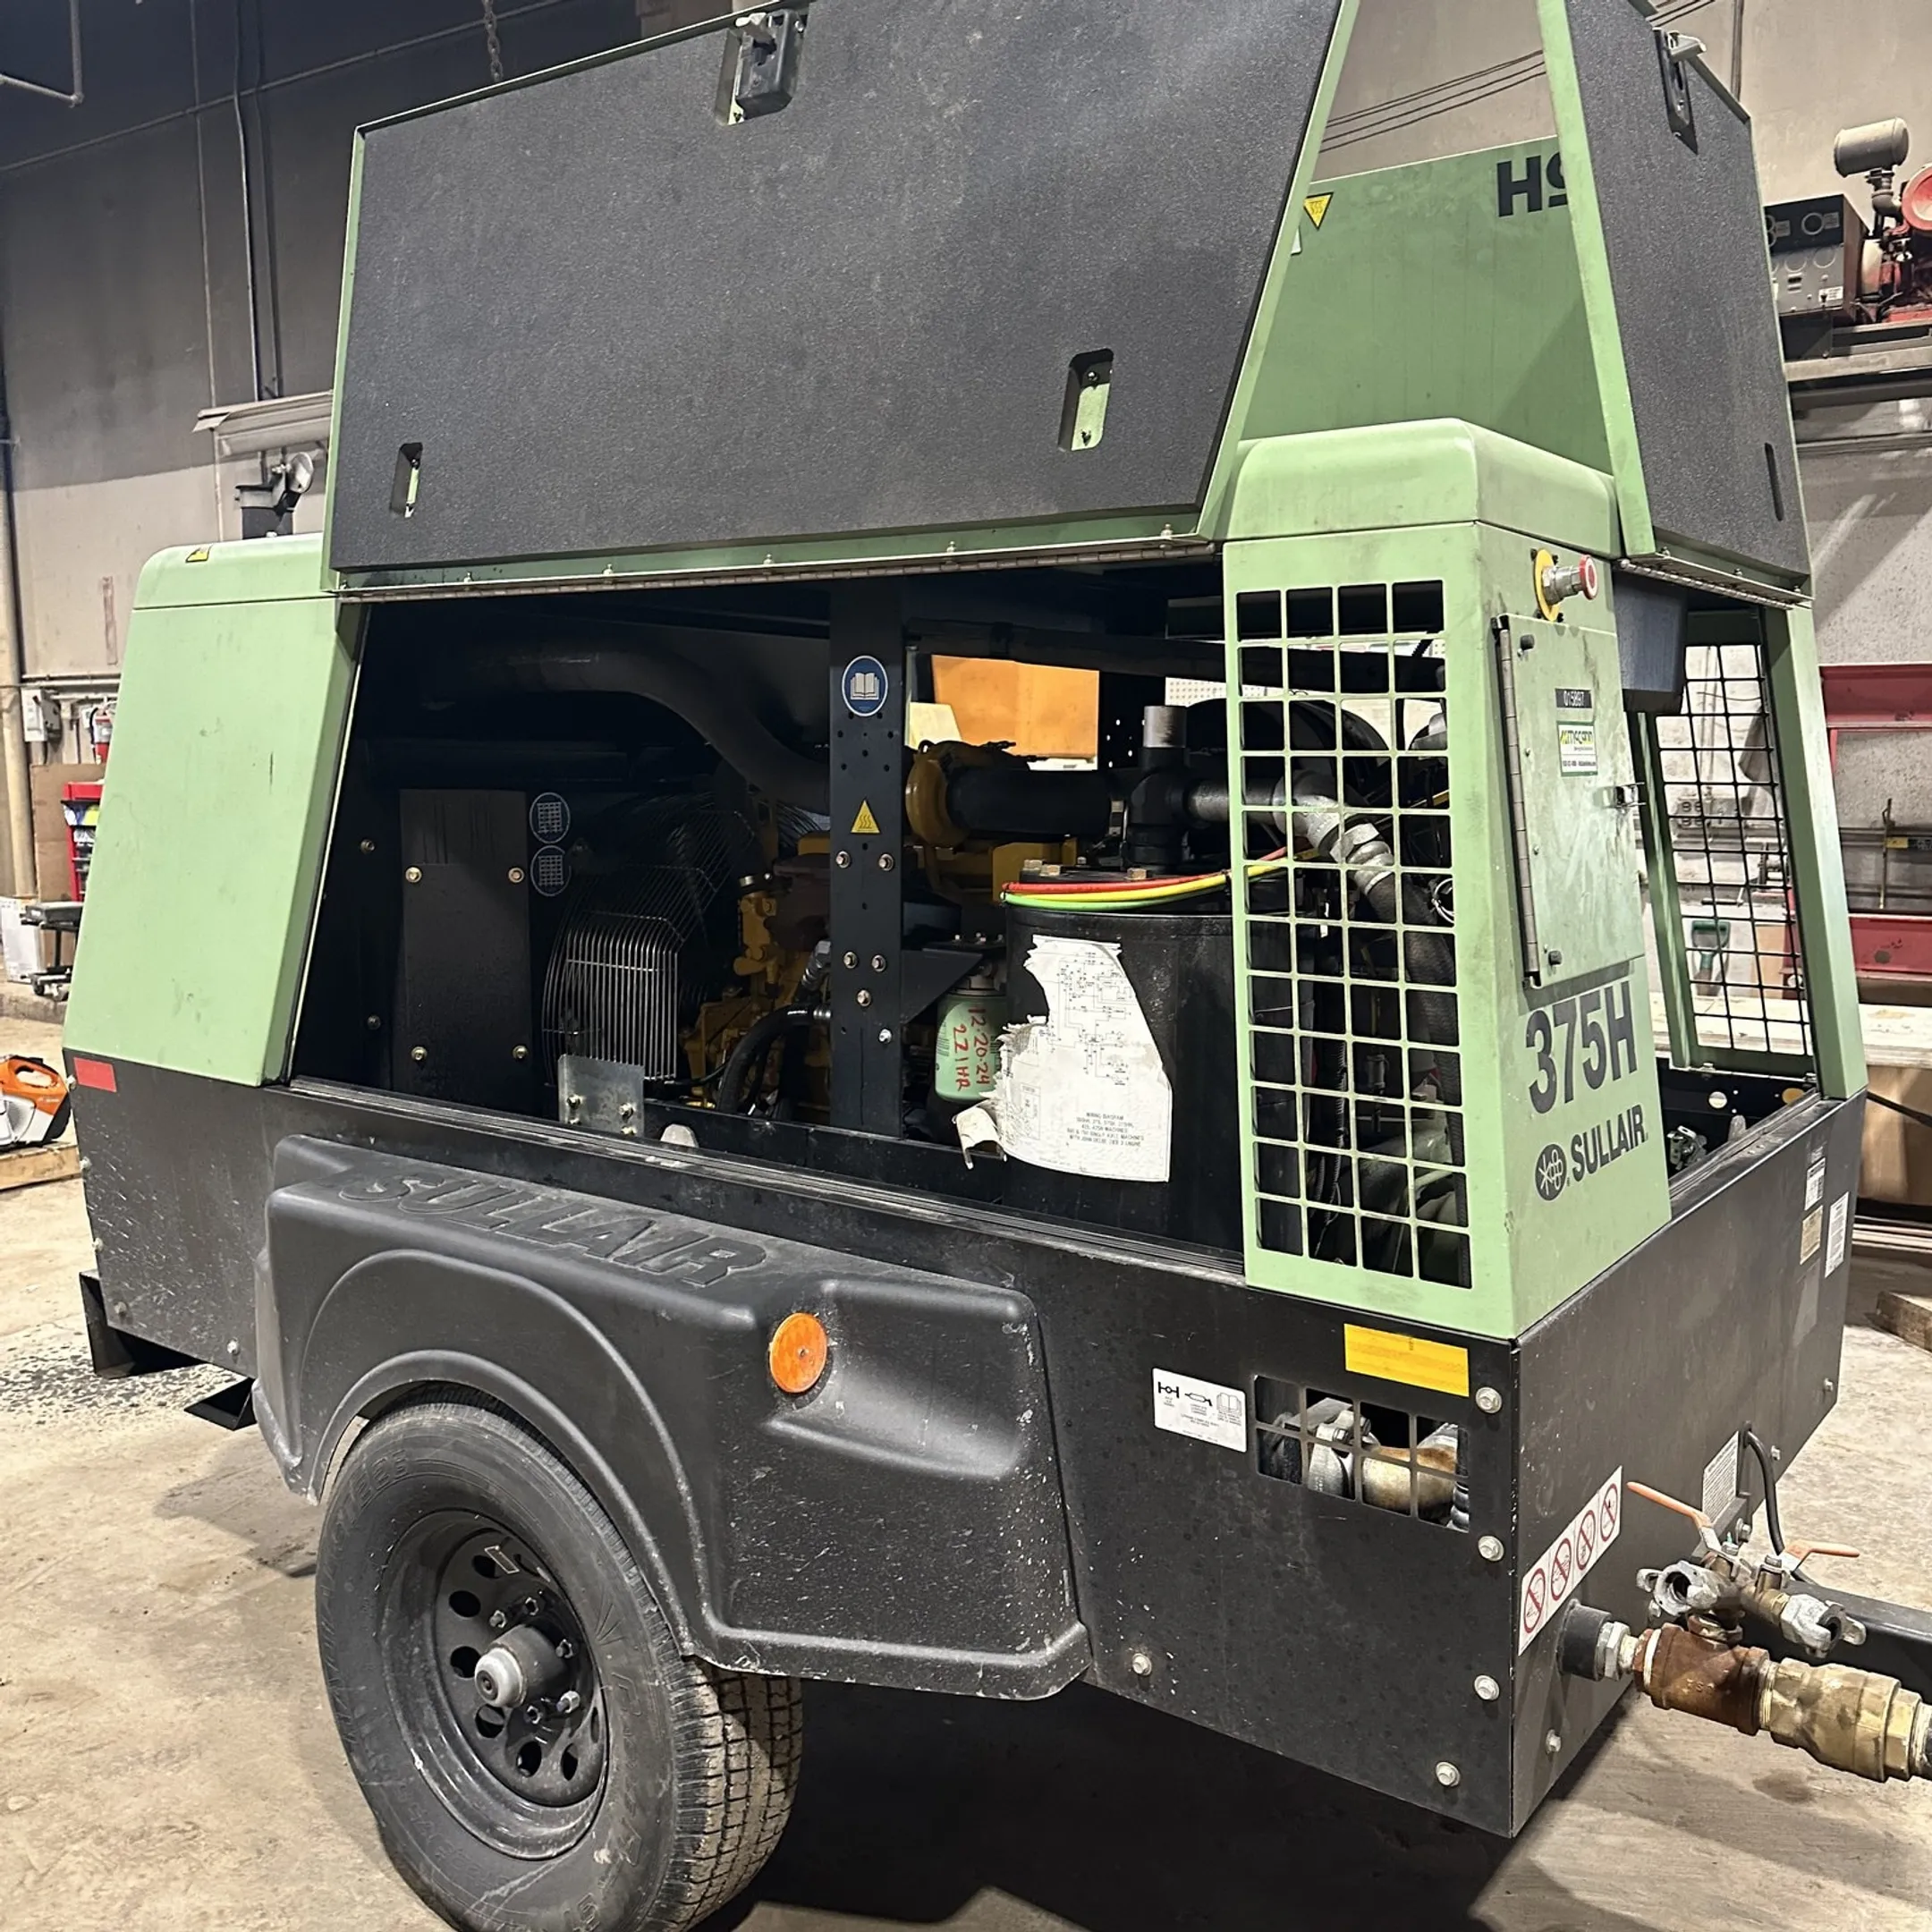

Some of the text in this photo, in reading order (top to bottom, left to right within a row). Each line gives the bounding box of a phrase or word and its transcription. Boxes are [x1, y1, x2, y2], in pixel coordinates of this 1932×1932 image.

[1525, 980, 1638, 1114] 375H
[1571, 1104, 1647, 1182] SULLAIR
[336, 1171, 768, 1288] SULLAIR
